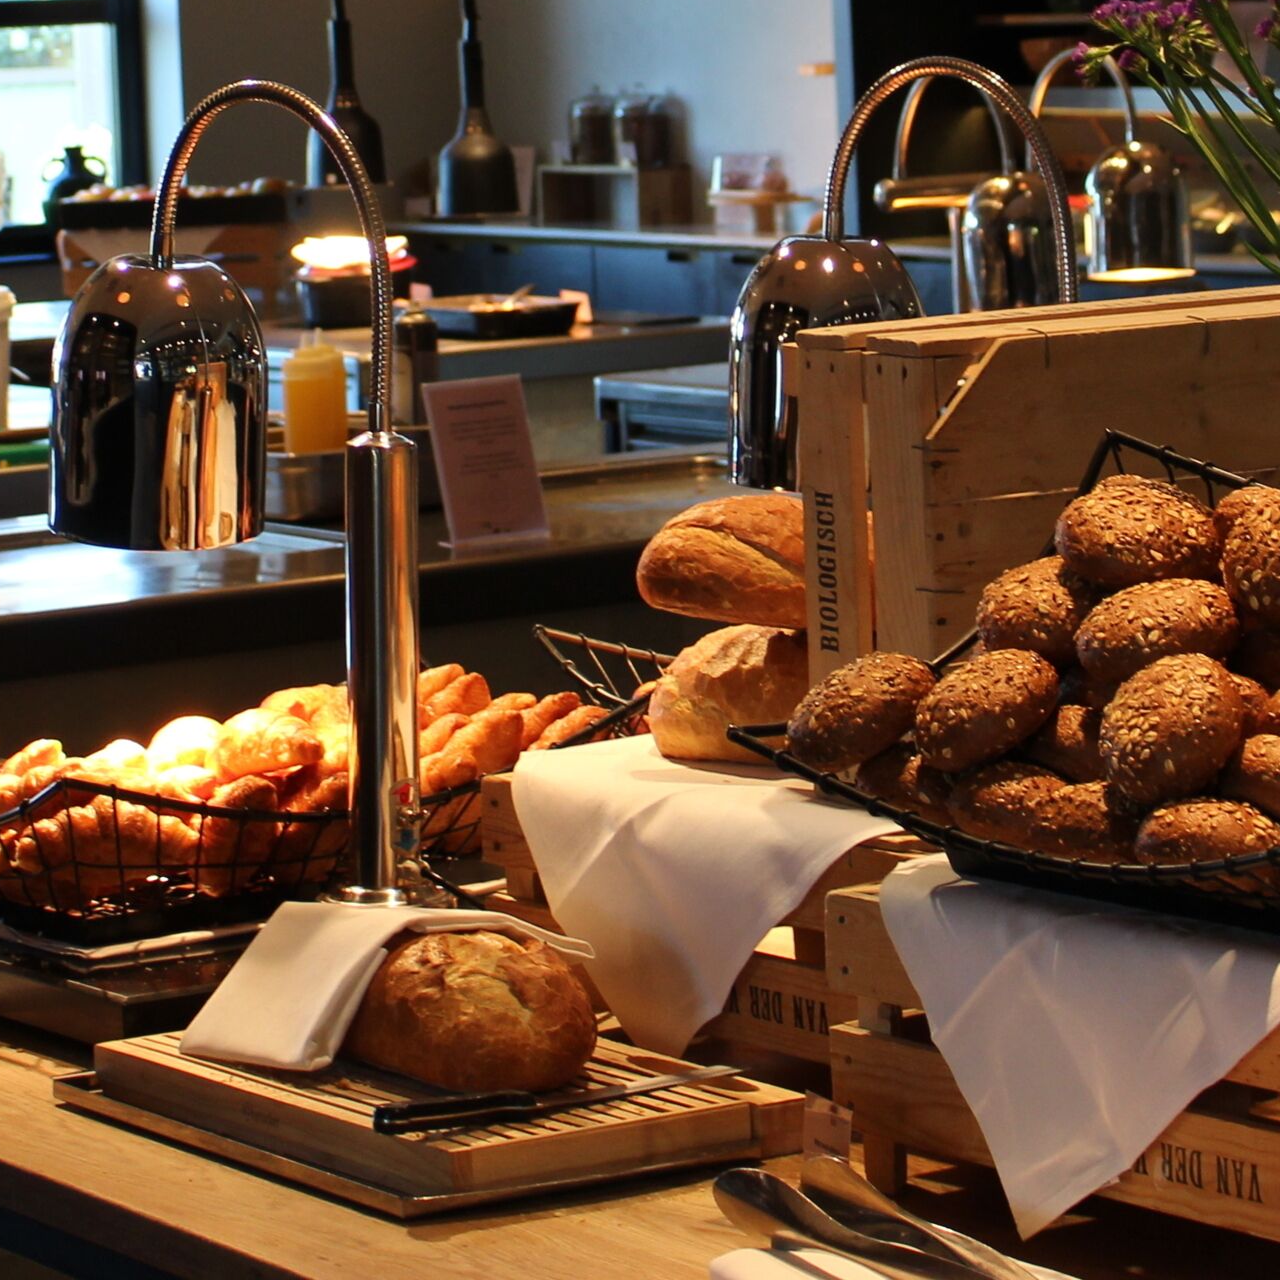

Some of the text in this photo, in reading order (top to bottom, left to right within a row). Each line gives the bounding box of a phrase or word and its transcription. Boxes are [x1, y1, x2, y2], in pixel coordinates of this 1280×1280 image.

[815, 491, 839, 652] BIOLOGISCH
[749, 985, 783, 1024] DER
[792, 995, 830, 1036] VAN
[1160, 1143, 1203, 1189] DER
[1216, 1155, 1263, 1204] VAN
